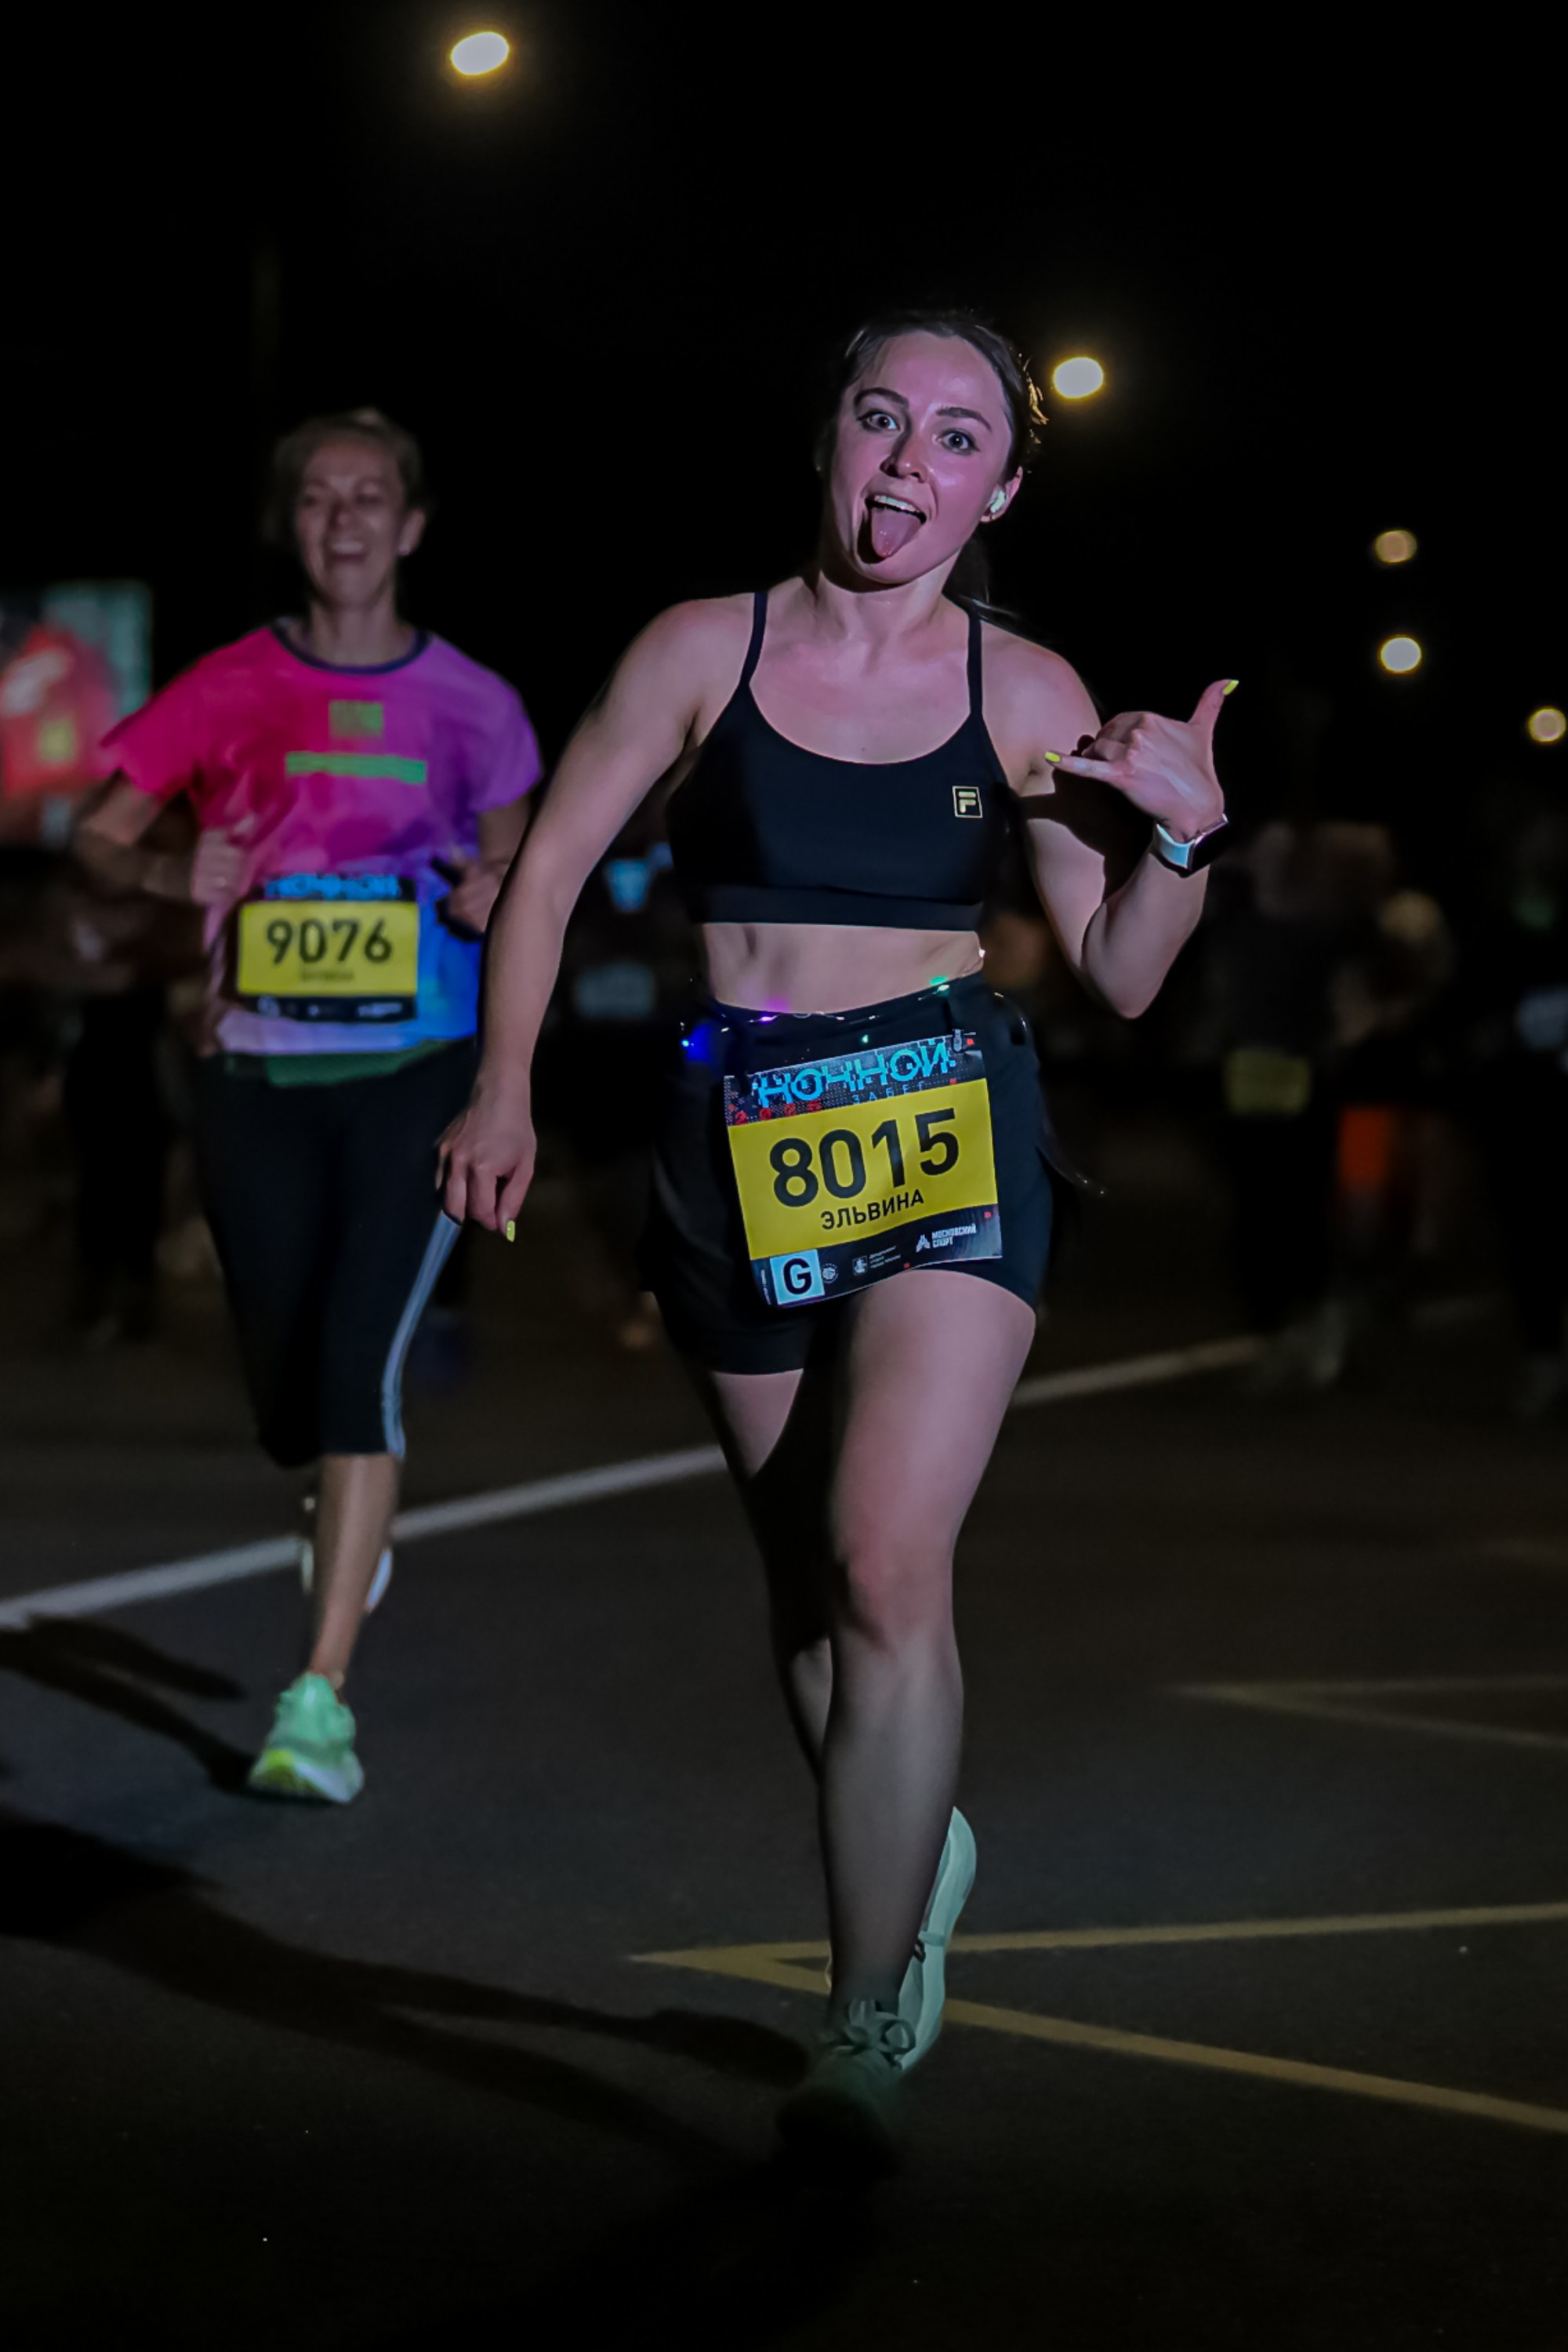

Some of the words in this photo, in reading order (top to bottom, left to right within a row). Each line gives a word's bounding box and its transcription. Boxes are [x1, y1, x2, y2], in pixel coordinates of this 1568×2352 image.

[267, 918, 393, 964] 9076
[757, 1039, 956, 1108] НОЧНОЙ
[852, 1081, 925, 1104] ЗАБЕГ
[769, 1108, 960, 1207] 8015
[820, 1189, 924, 1230] ЭЛЬВИНА
[782, 1258, 812, 1295] G
